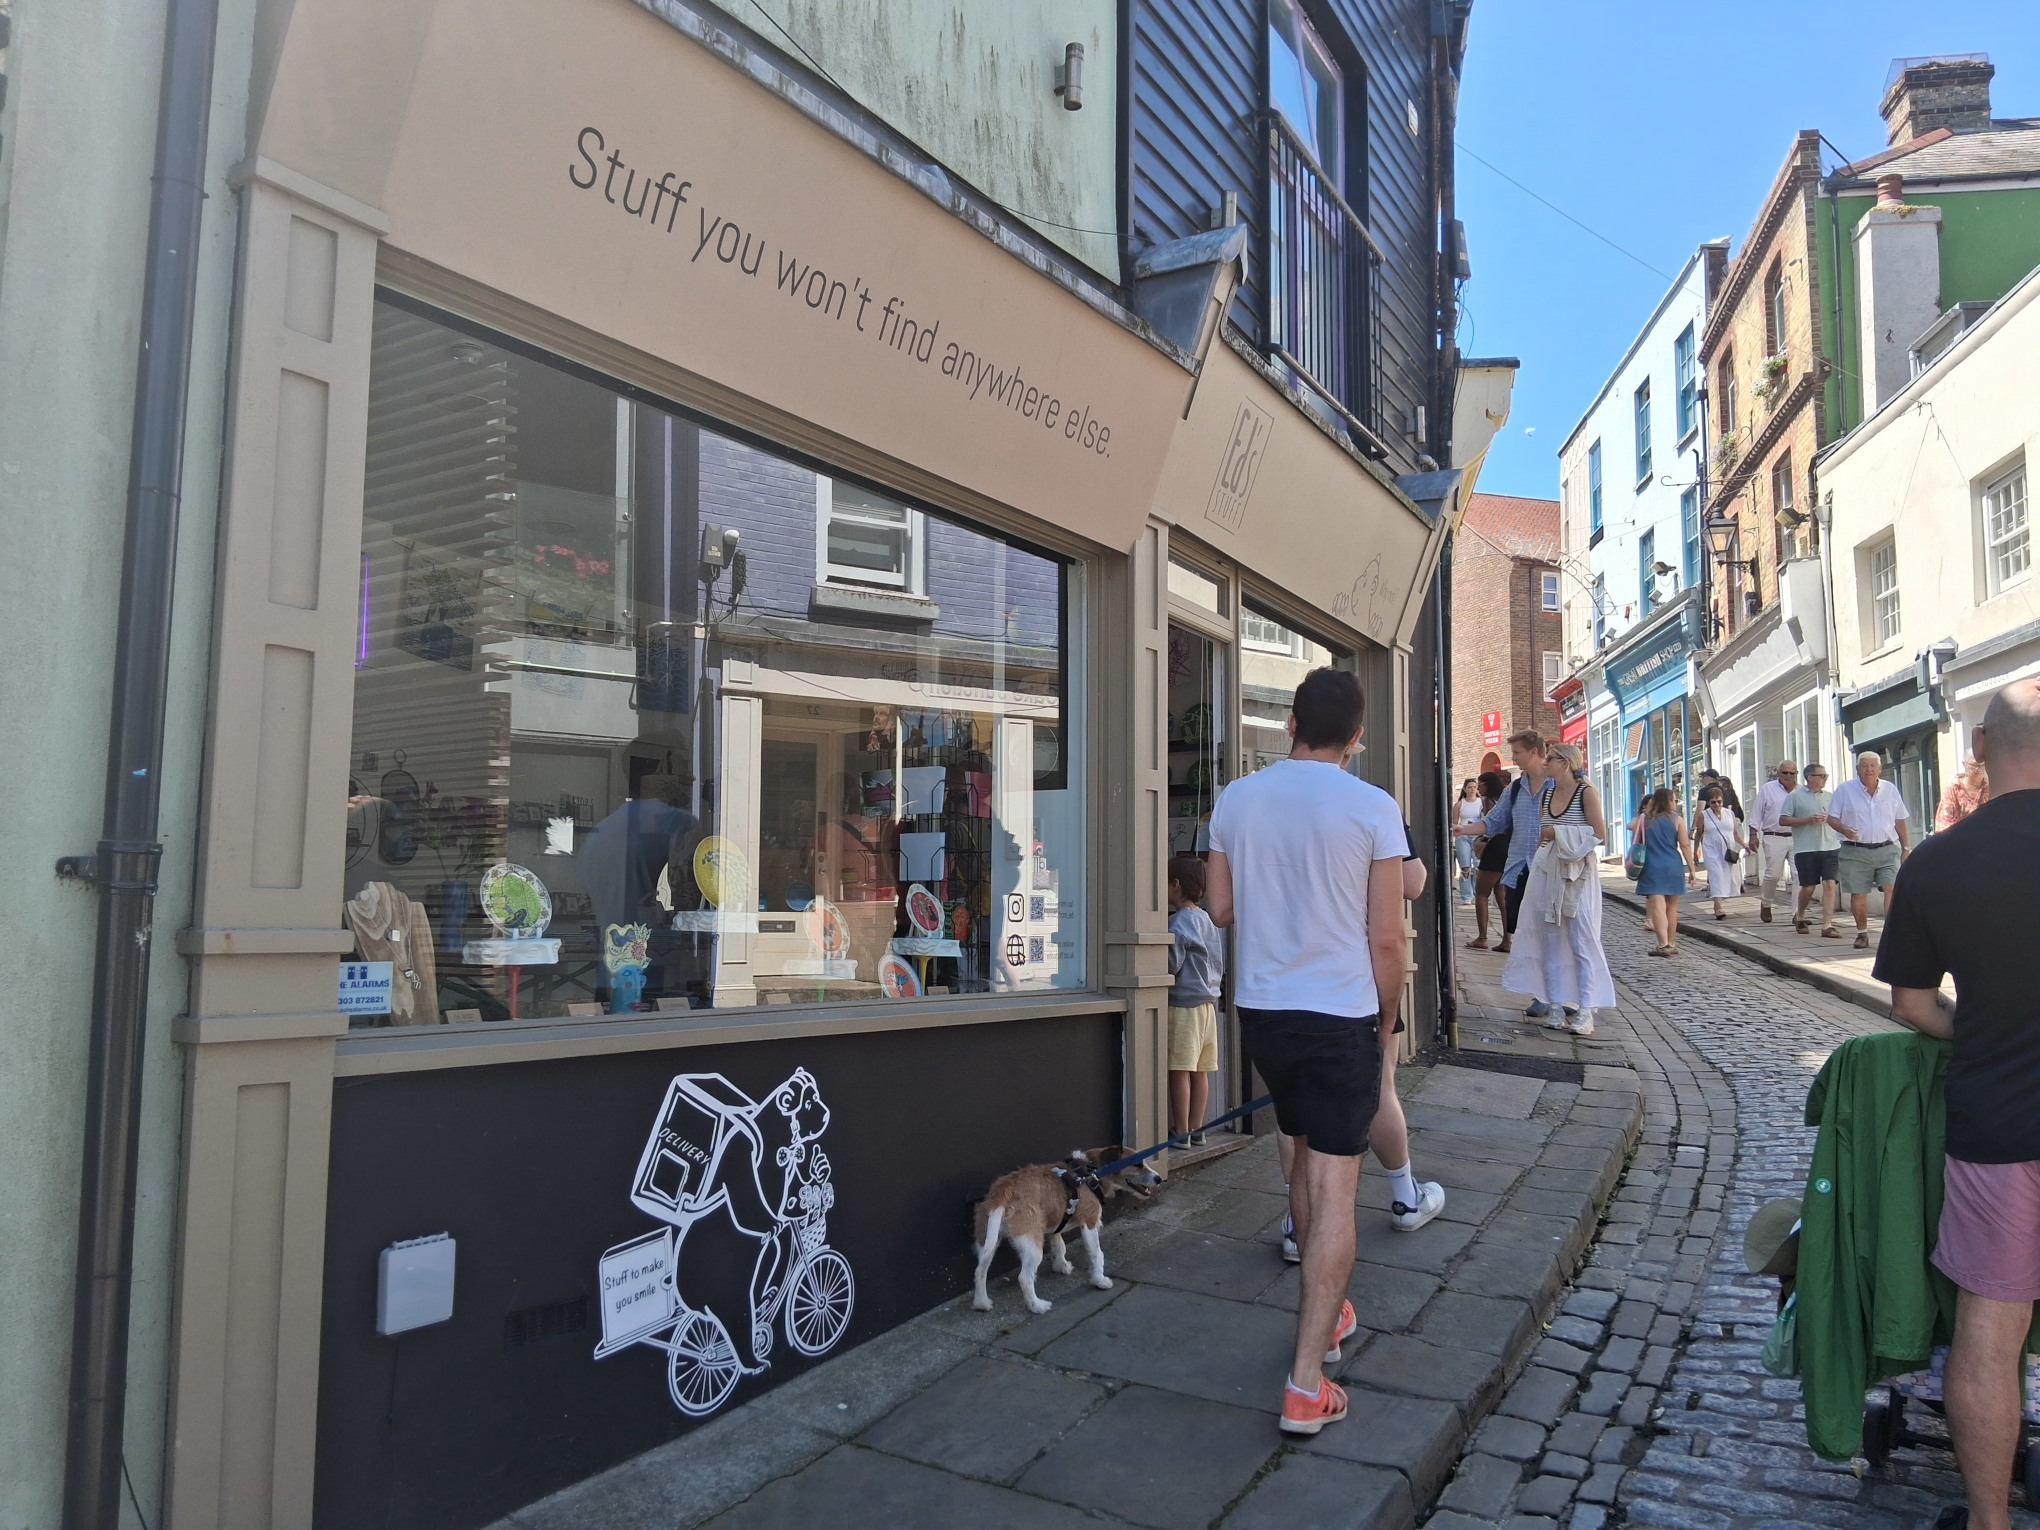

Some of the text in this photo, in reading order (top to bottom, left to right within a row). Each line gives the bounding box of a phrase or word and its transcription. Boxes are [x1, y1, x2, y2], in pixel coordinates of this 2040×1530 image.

[568, 126, 1111, 459] Stuff you won't find anywhere else.
[1221, 408, 1263, 498] Ed's
[1211, 489, 1242, 524] STUFF
[1635, 652, 1663, 677] BRITISH
[1659, 645, 1674, 662] SHOP
[350, 979, 390, 989] ALARMS
[659, 1127, 711, 1164] DELIVERY
[605, 1258, 664, 1290] Stuff to make
[616, 1282, 656, 1313] you smile
